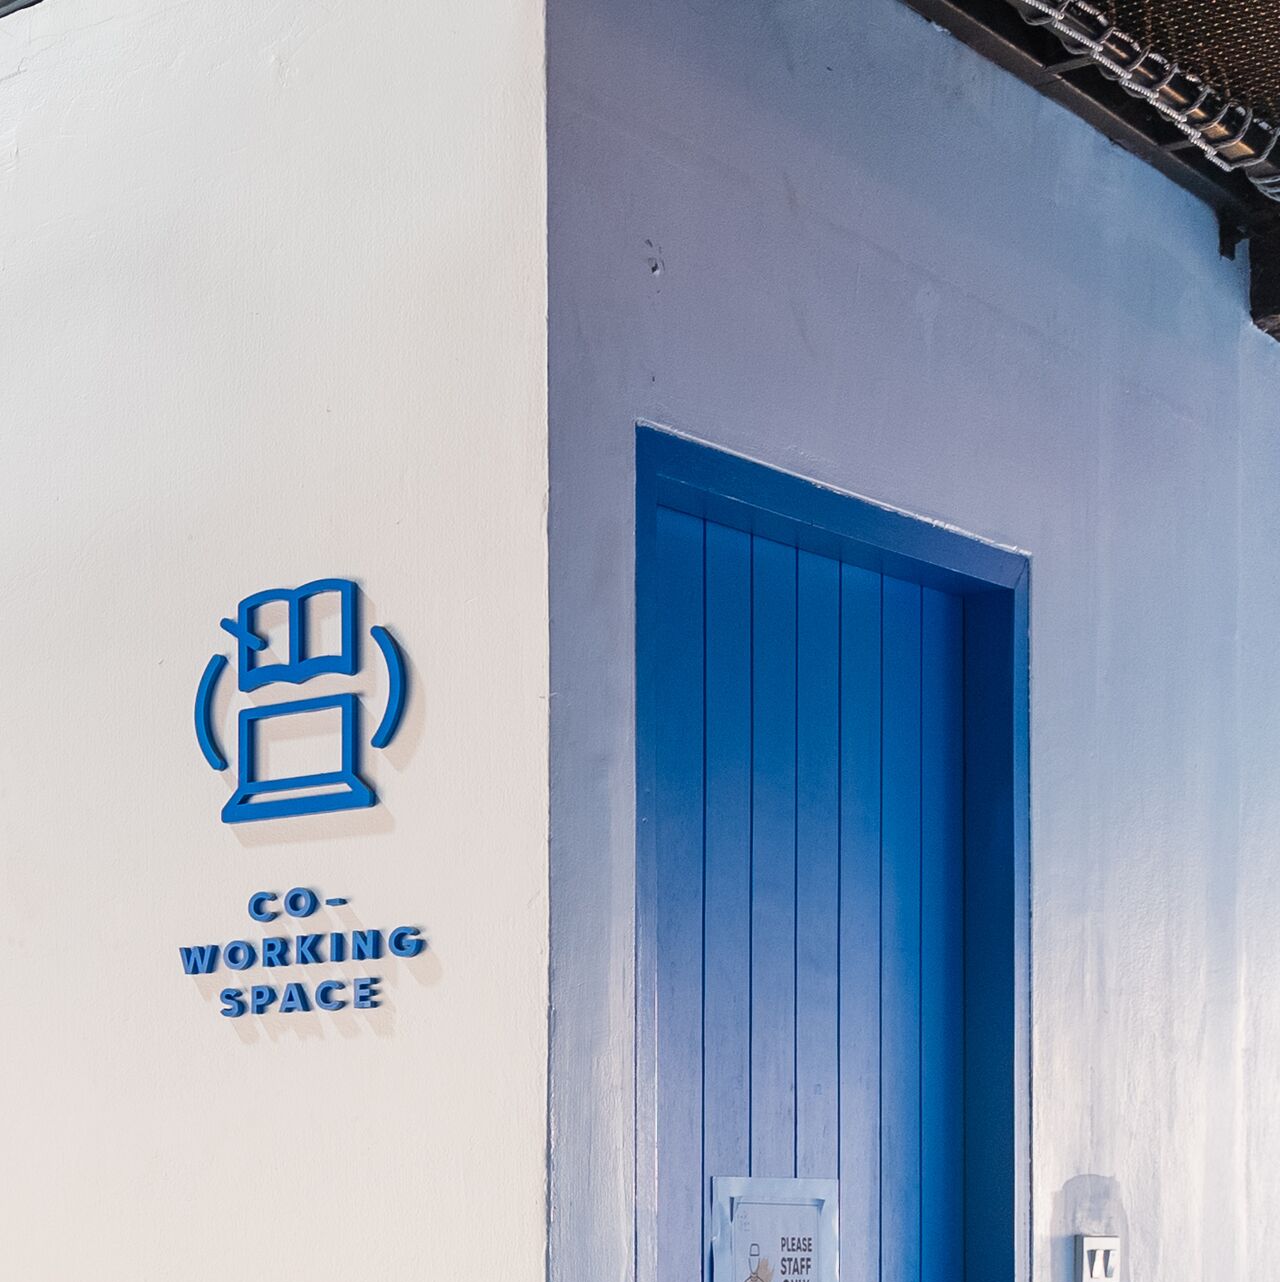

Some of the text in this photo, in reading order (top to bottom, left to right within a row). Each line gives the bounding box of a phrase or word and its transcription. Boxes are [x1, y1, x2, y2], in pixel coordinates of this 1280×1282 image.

[248, 886, 348, 922] CO-
[179, 926, 426, 975] WORKING
[219, 976, 383, 1018] SPACE
[781, 1237, 812, 1252] PLEASE
[780, 1257, 811, 1275] STAFF
